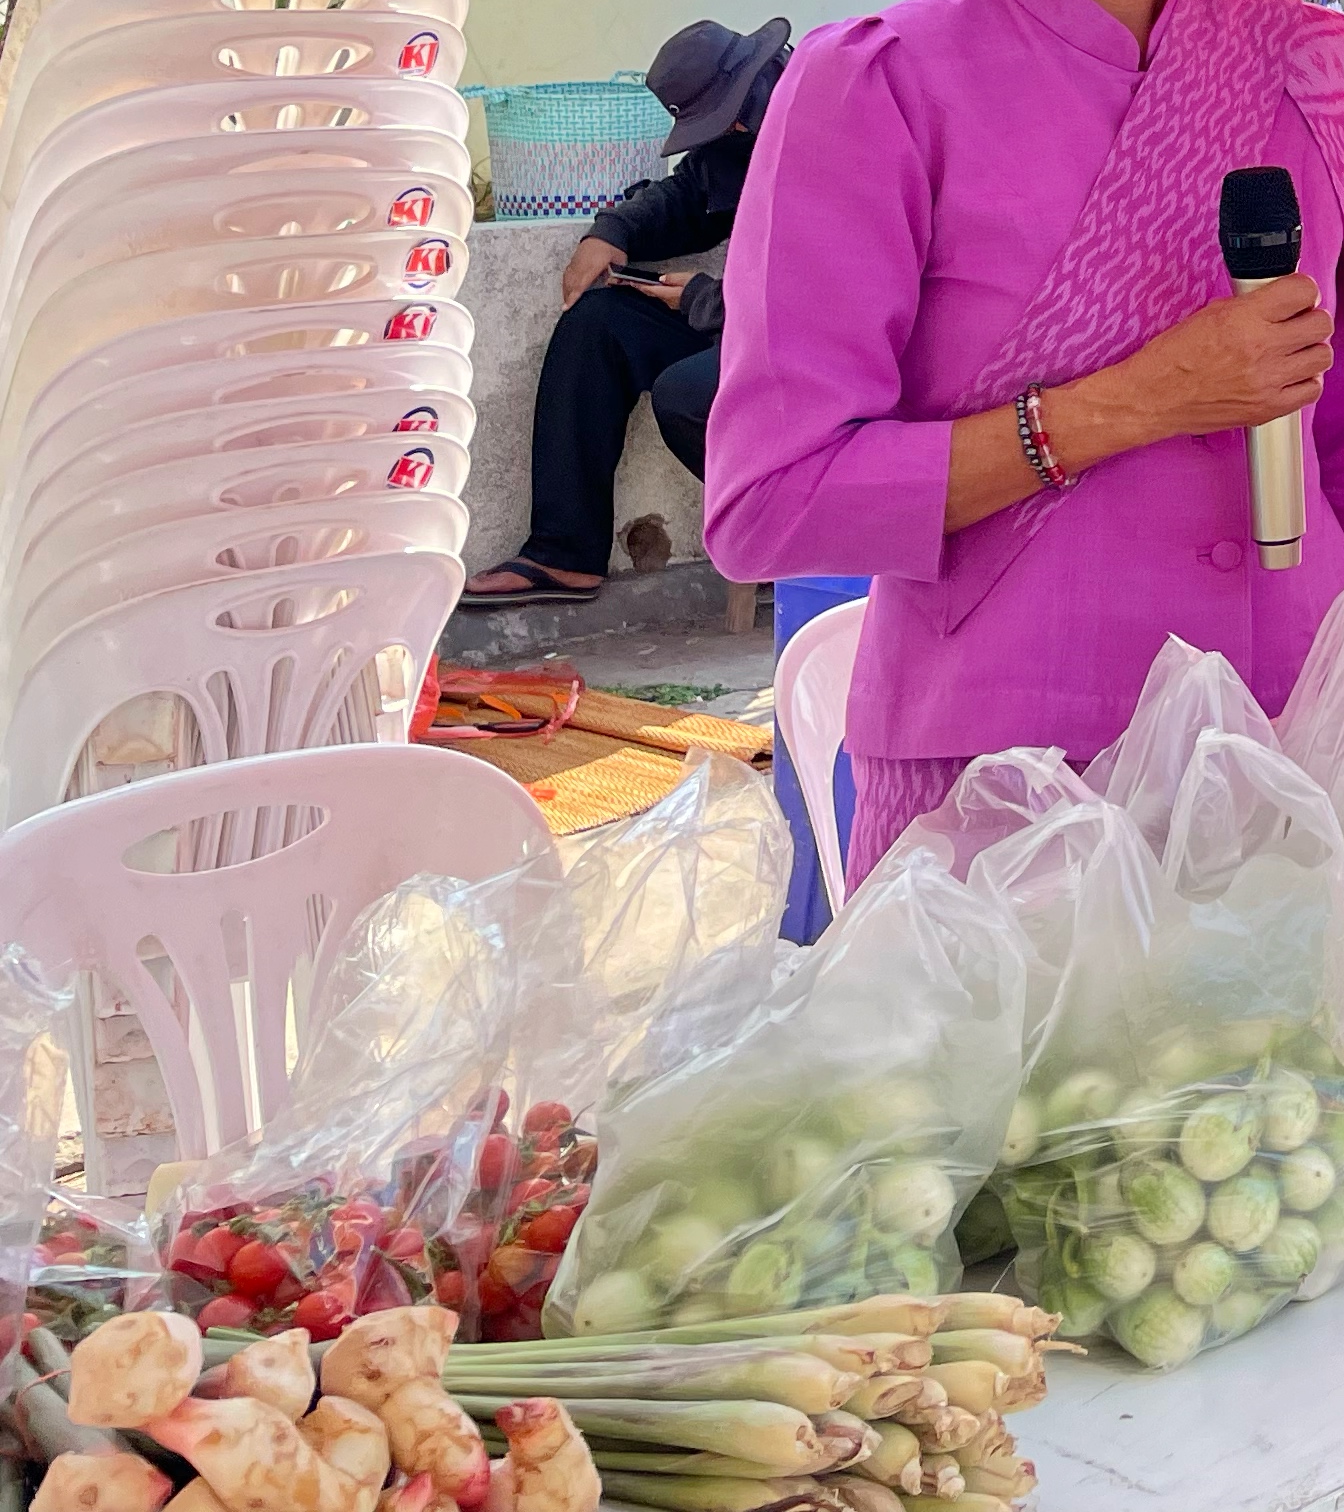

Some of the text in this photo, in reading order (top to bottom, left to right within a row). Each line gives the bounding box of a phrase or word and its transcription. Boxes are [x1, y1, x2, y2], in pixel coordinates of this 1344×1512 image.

[401, 42, 438, 76] KJ
[389, 196, 434, 227] KJ
[408, 248, 446, 275] KJ
